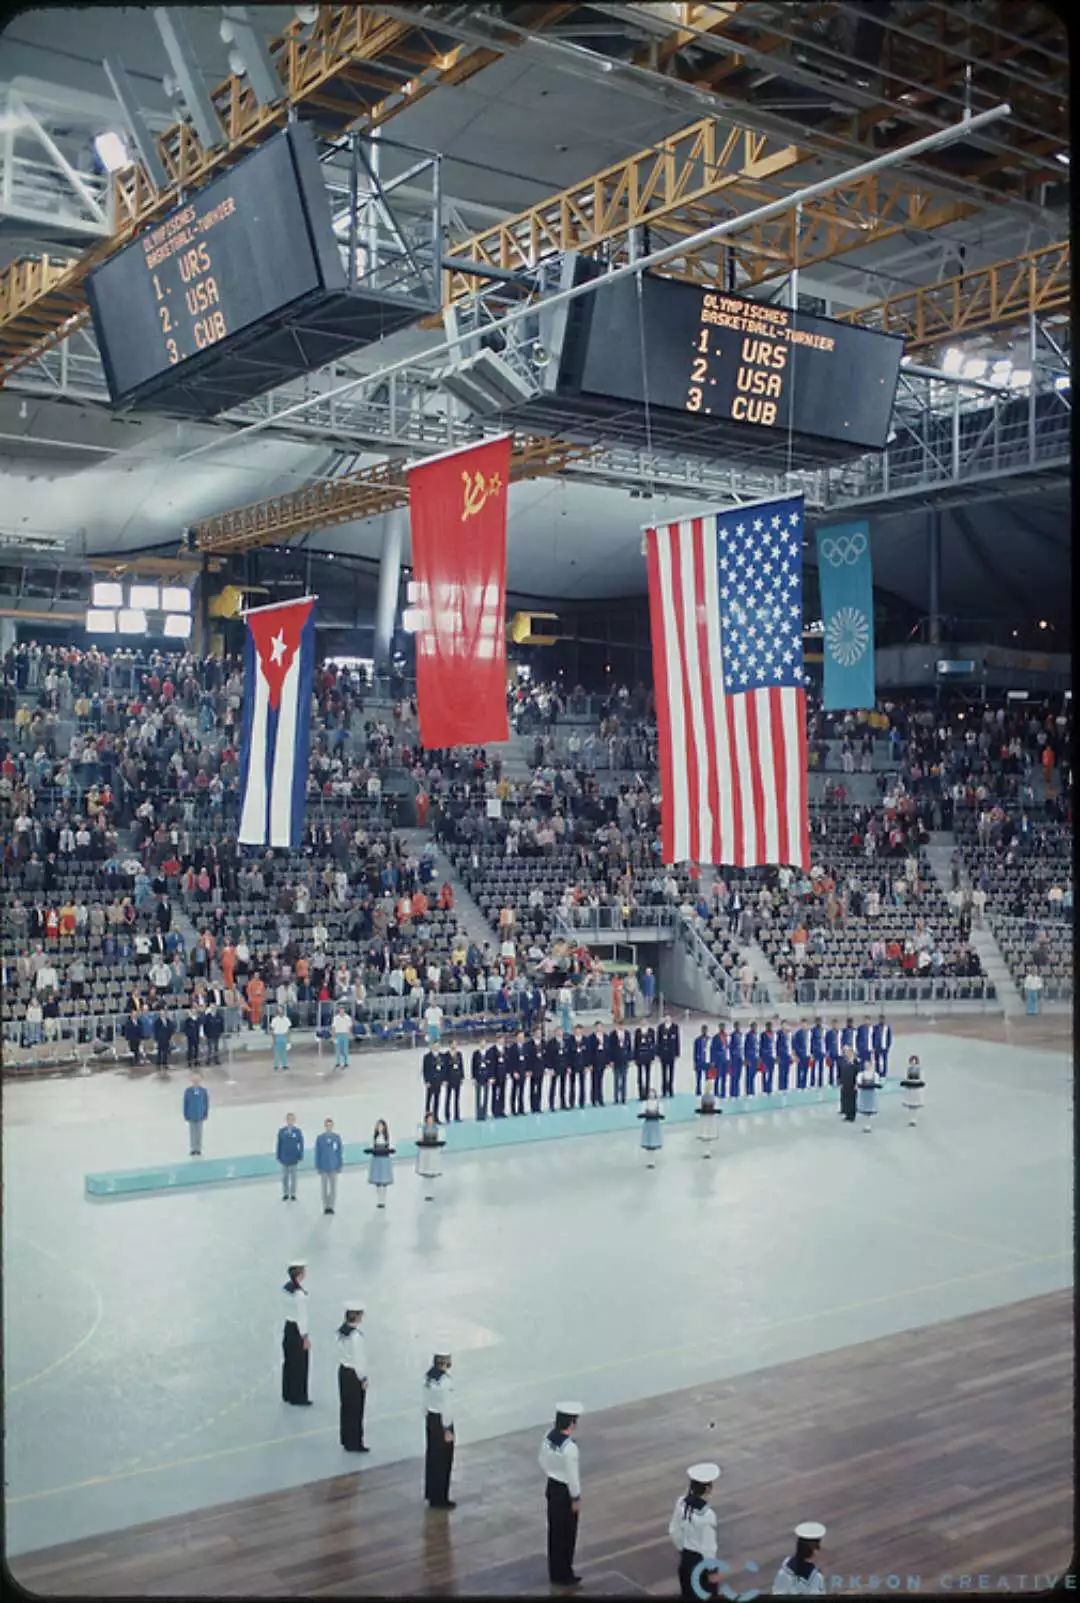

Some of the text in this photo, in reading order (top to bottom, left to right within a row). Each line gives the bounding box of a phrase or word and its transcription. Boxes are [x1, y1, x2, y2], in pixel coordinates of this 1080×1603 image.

[153, 242, 211, 300] 1. URS
[160, 277, 220, 334] 2. USA
[702, 293, 789, 326] OLYMPISCHES
[166, 311, 227, 364] 3. CUB
[697, 328, 788, 369] 1. URS
[701, 309, 836, 352] BASKETBALL-TURNIER
[690, 358, 782, 398] 2. USA
[685, 386, 777, 426] 3. CUB
